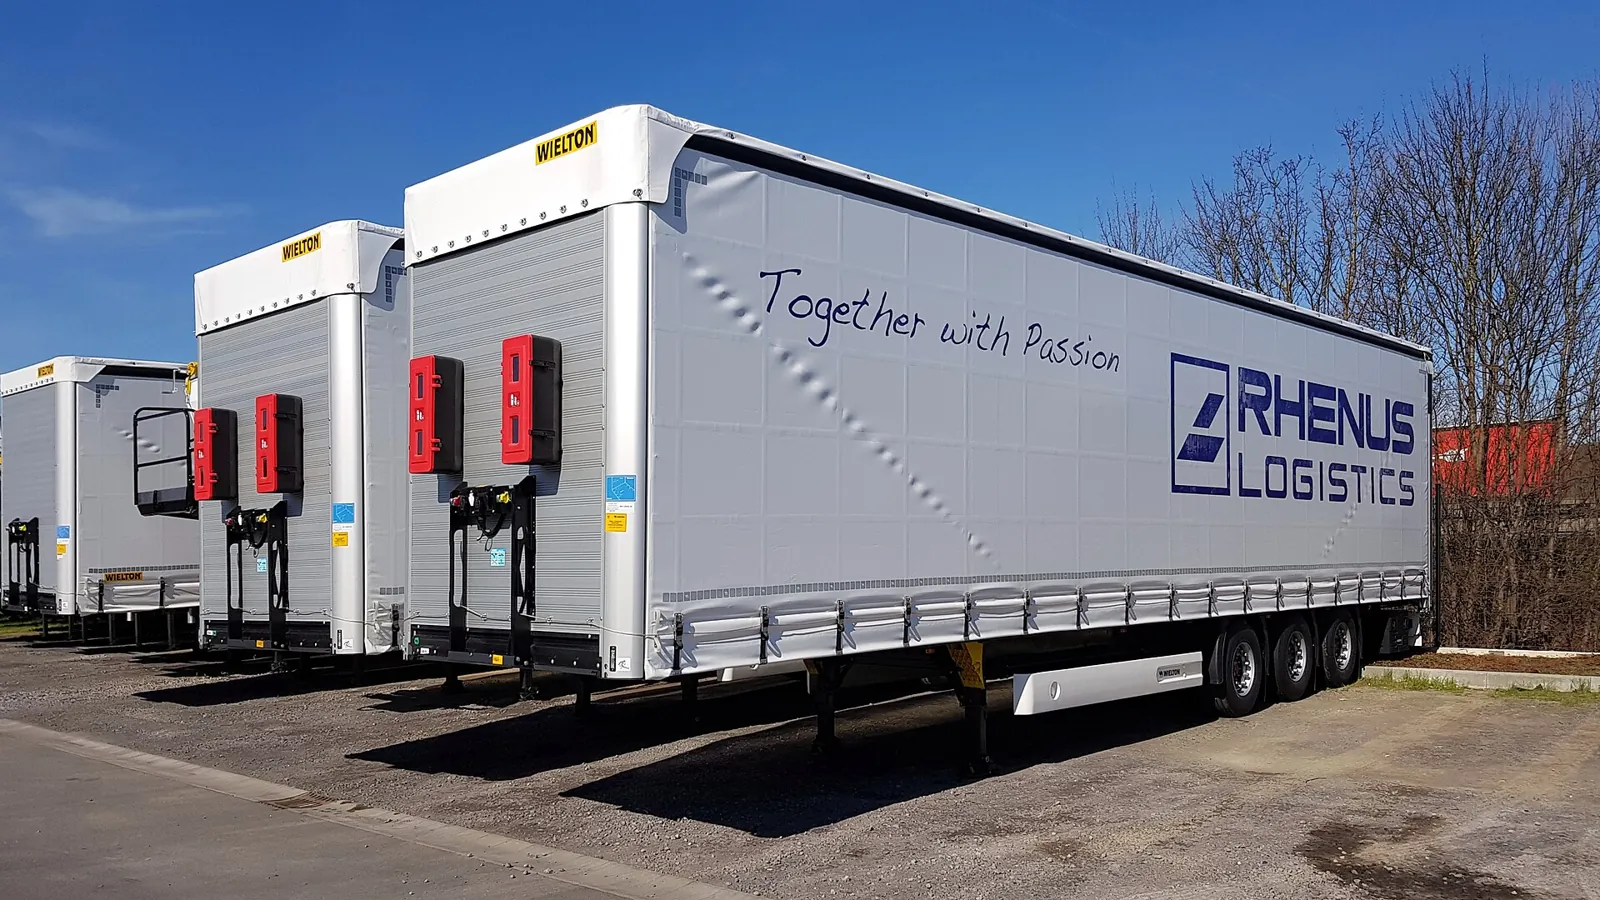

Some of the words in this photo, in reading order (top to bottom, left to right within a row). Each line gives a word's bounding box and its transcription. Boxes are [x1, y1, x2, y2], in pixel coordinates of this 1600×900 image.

[536, 122, 595, 163] WIELTON
[282, 233, 320, 261] WIELTON
[759, 268, 926, 347] Together
[940, 309, 1010, 357] with
[1023, 322, 1120, 372] Passion
[1238, 366, 1414, 455] RHENUS
[1238, 452, 1414, 507] LOGISTICS
[104, 572, 142, 582] WIELTON
